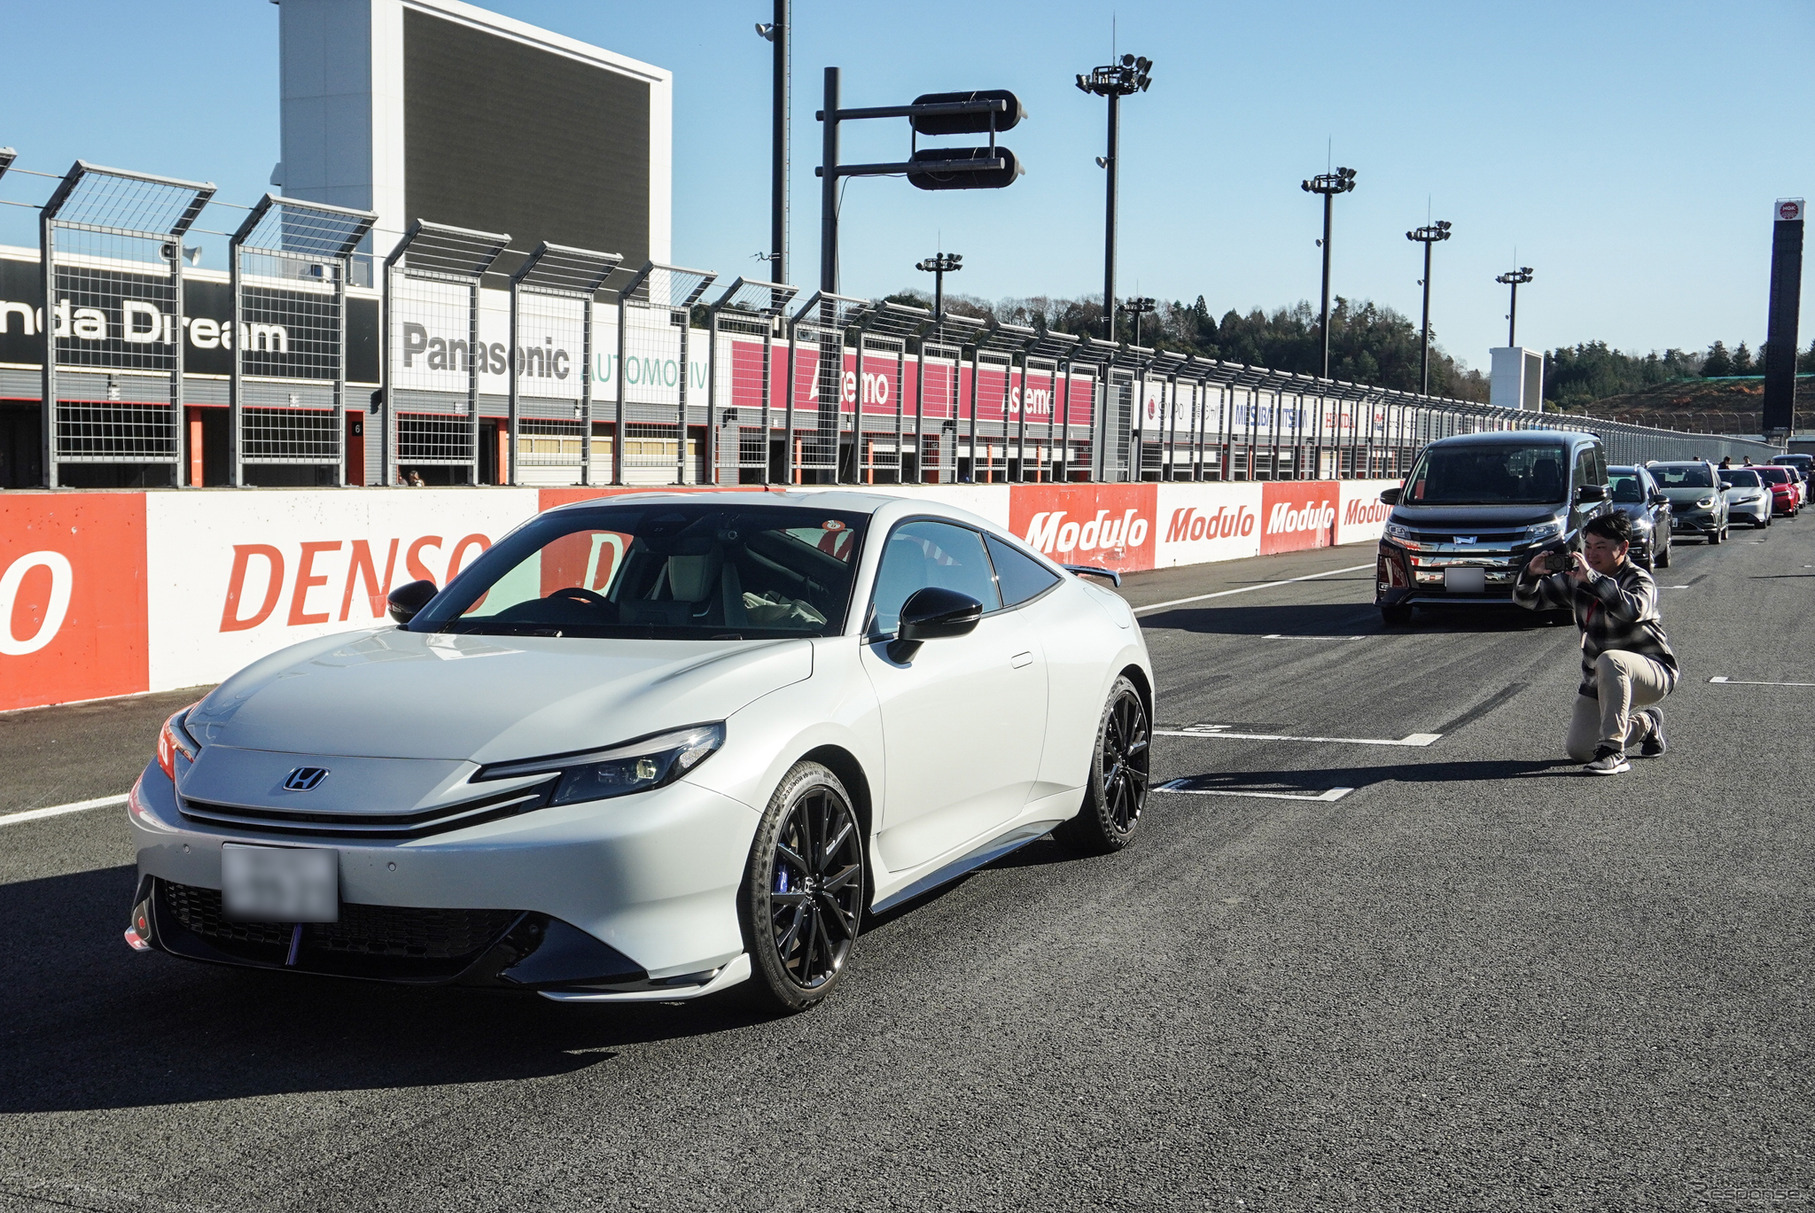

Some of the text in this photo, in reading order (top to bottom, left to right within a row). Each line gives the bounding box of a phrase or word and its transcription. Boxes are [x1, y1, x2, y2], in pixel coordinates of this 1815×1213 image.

[123, 300, 288, 353] Dream
[580, 353, 708, 389] AUOMOIV
[809, 359, 889, 405] Aemo
[1001, 385, 1052, 415] Asem
[1025, 508, 1149, 554] Modulo
[1165, 504, 1255, 543] Modulo
[1266, 500, 1336, 535] Modulo
